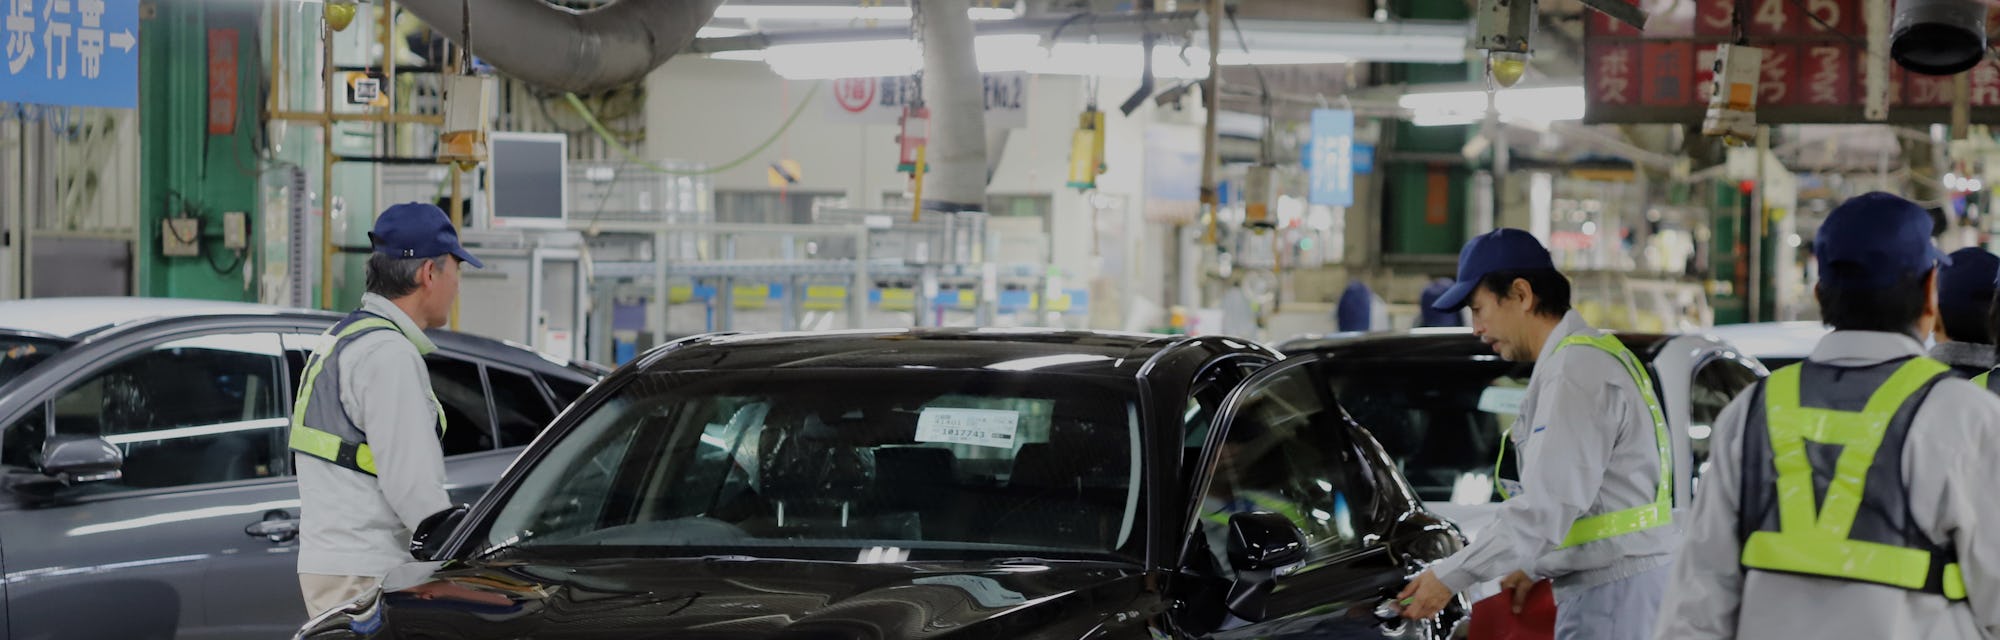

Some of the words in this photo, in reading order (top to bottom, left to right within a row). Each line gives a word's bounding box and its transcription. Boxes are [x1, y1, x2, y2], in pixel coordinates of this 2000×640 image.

[6, 0, 104, 79] 歩行帯
[1754, 0, 1786, 33] 4
[1806, 0, 1840, 32] 5
